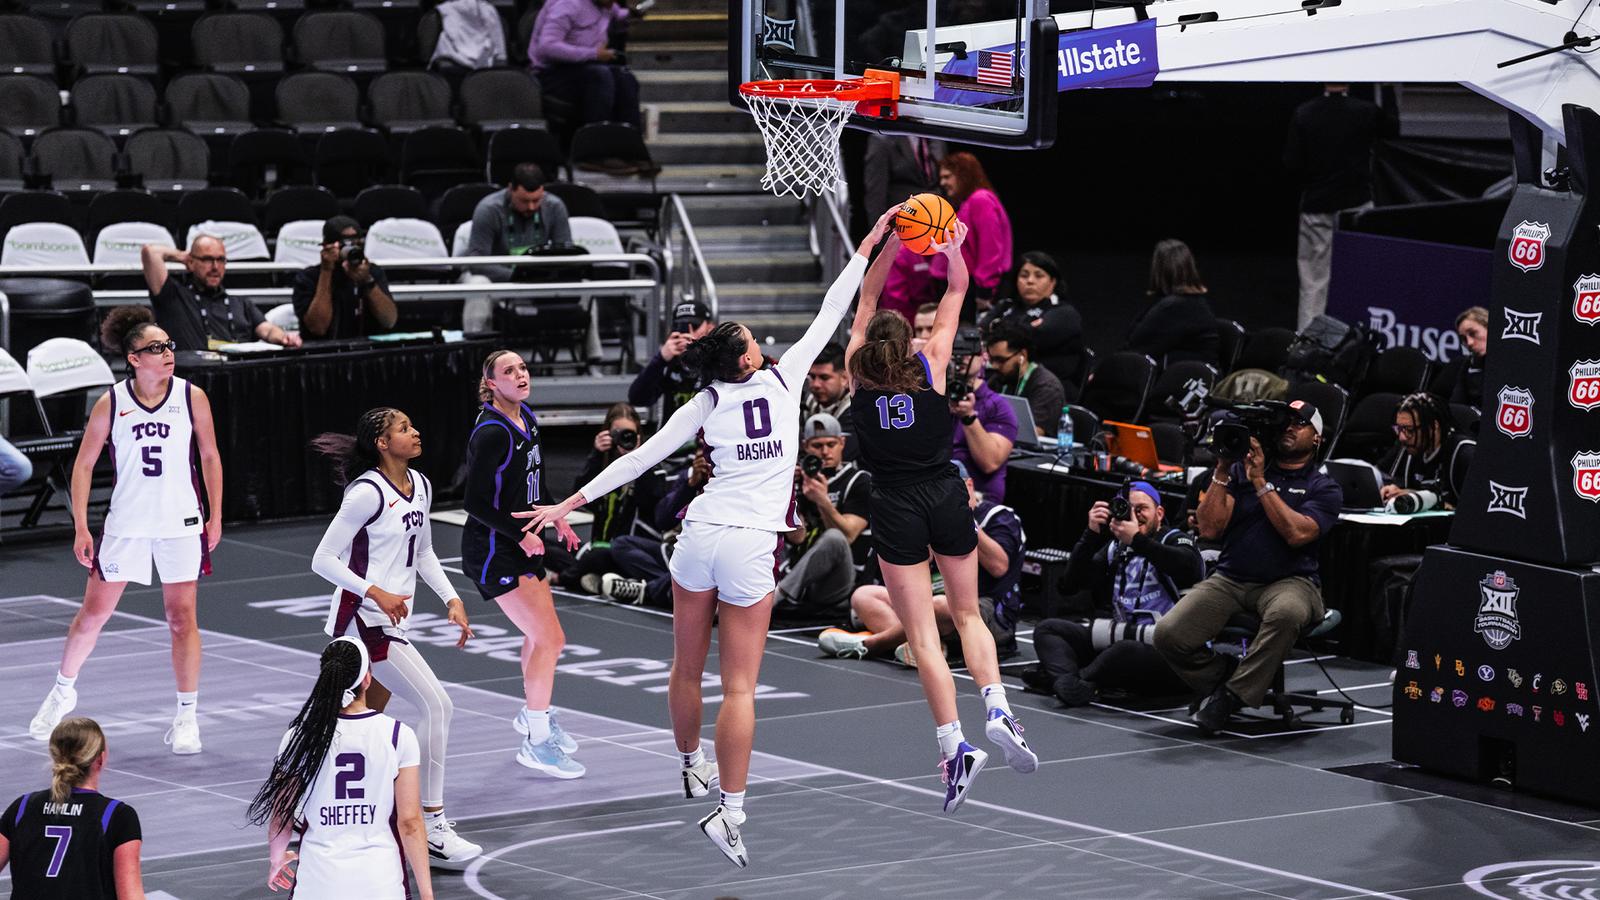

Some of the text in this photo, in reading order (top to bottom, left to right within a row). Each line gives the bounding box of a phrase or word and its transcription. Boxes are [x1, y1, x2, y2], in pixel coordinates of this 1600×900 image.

[1519, 227, 1546, 239] PHILLIPS
[1515, 241, 1539, 261] 66
[1581, 294, 1600, 314] 66
[1367, 306, 1472, 364] Buse
[1503, 393, 1529, 406] PHILLIPS
[1576, 381, 1600, 400] 66
[743, 398, 772, 439] 0
[875, 394, 915, 430] 13
[1503, 407, 1526, 427] 66
[131, 422, 171, 441] TCU
[737, 439, 783, 461] BASHAM
[141, 446, 163, 477] 5
[526, 468, 540, 505] 11
[1581, 471, 1600, 491] 66
[402, 511, 424, 534] TCU
[406, 534, 417, 568] 1
[1480, 585, 1517, 618] XII
[1477, 621, 1518, 635] TOURNAMENT
[1478, 615, 1517, 629] BASKETBALL
[335, 753, 366, 800] 2
[42, 801, 84, 817] HAMLIN
[320, 804, 377, 826] SHEFFEY
[45, 825, 73, 878] 7
